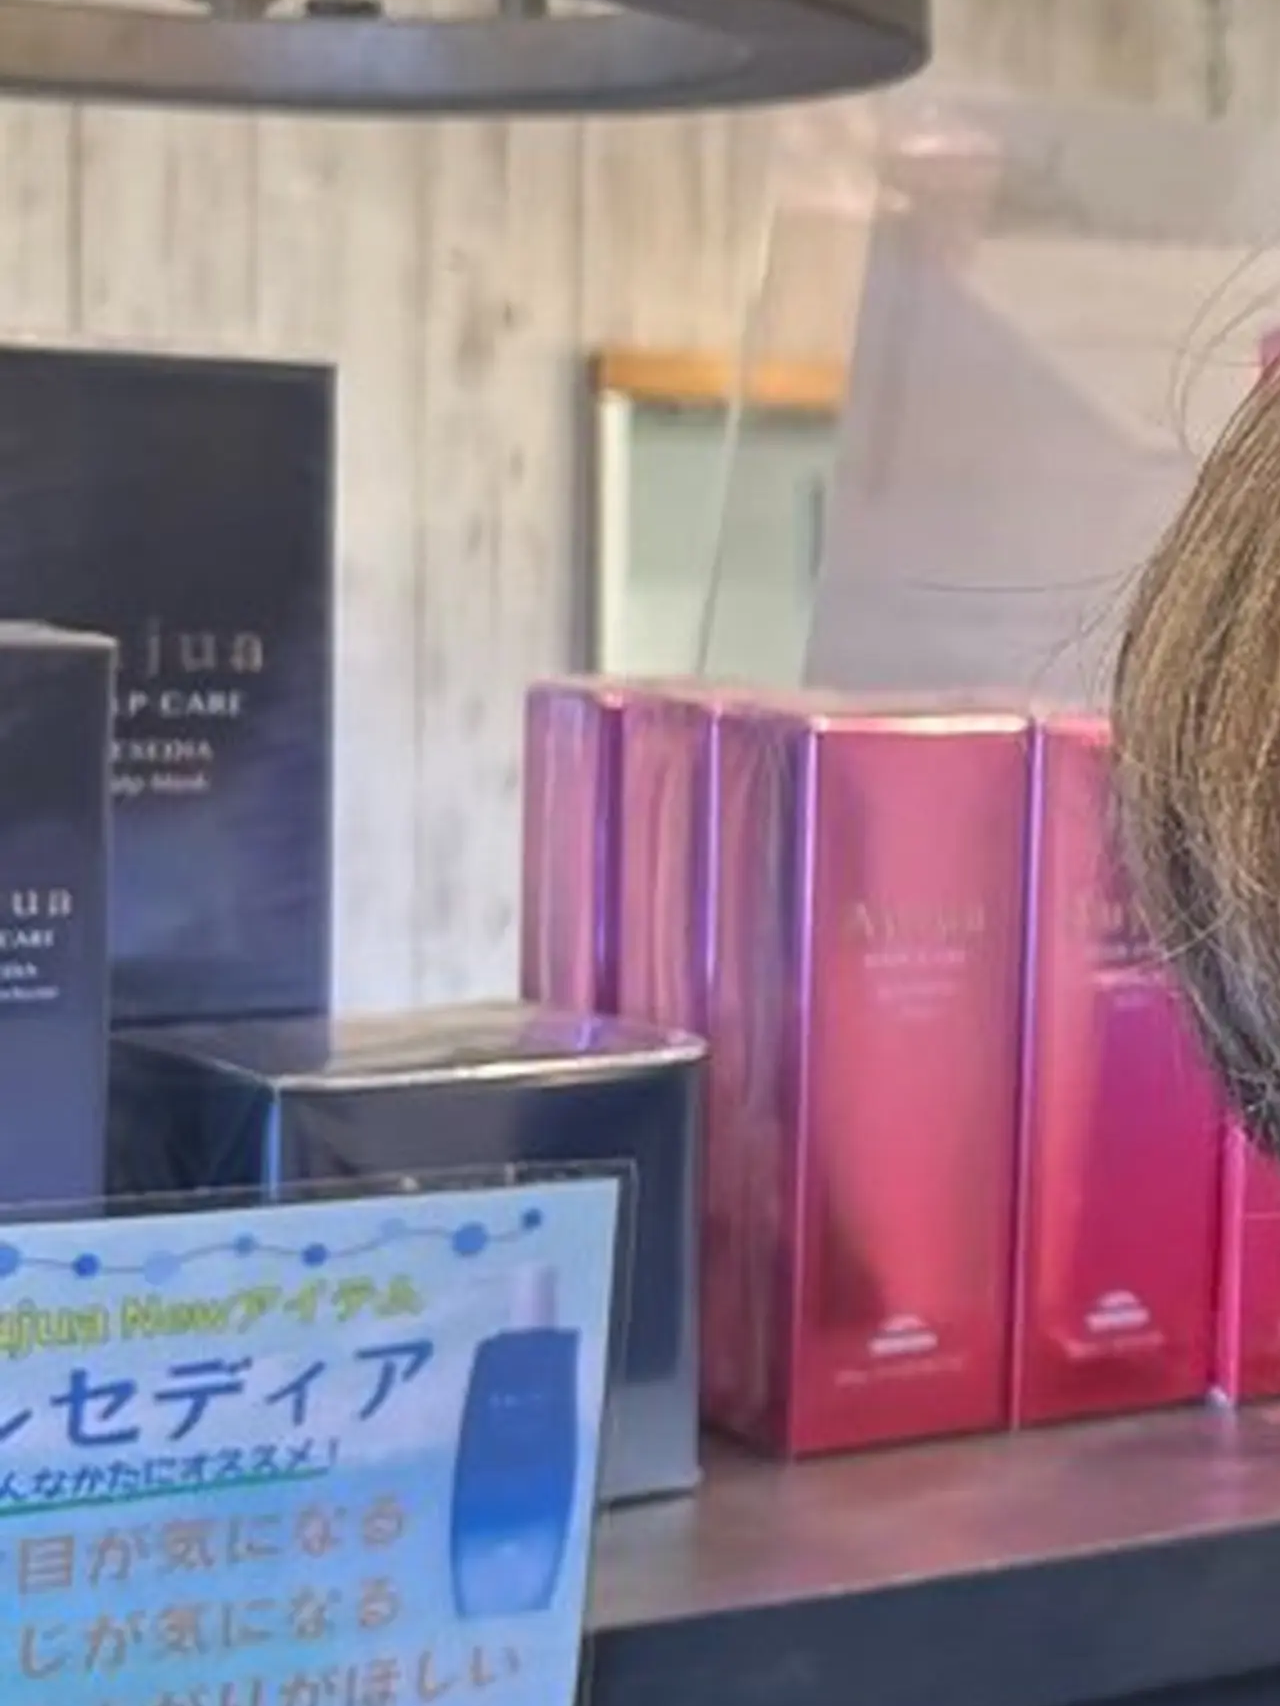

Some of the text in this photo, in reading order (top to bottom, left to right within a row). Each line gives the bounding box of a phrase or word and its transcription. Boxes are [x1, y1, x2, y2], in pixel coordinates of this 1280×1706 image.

[116, 615, 263, 679] jua
[0, 1496, 406, 1594] 目が気になる
